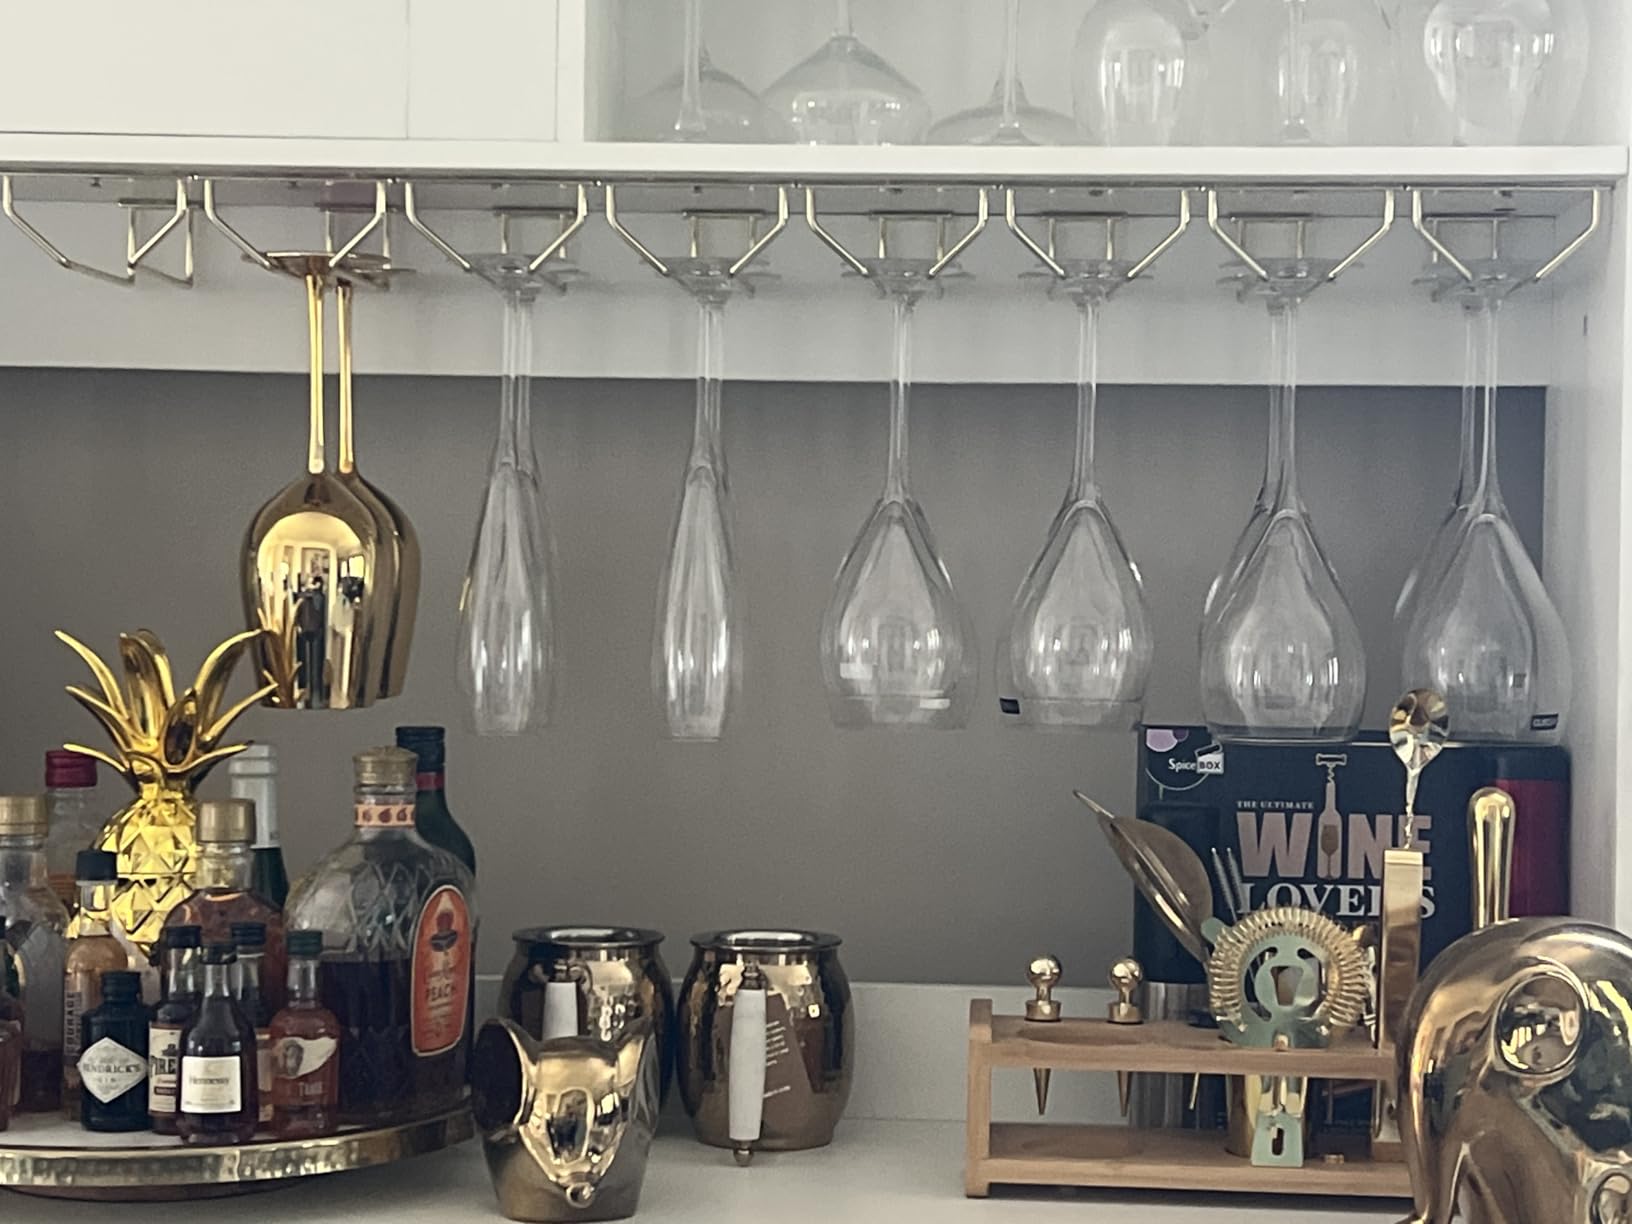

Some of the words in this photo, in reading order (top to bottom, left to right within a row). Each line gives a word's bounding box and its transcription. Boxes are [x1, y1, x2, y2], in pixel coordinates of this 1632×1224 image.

[1168, 758, 1197, 773] Spice
[1199, 761, 1221, 770] BOX
[1237, 801, 1258, 809] THE
[1260, 801, 1315, 810] ULTIMATE
[1236, 811, 1432, 881] WINE
[148, 1055, 177, 1078] FIRE
